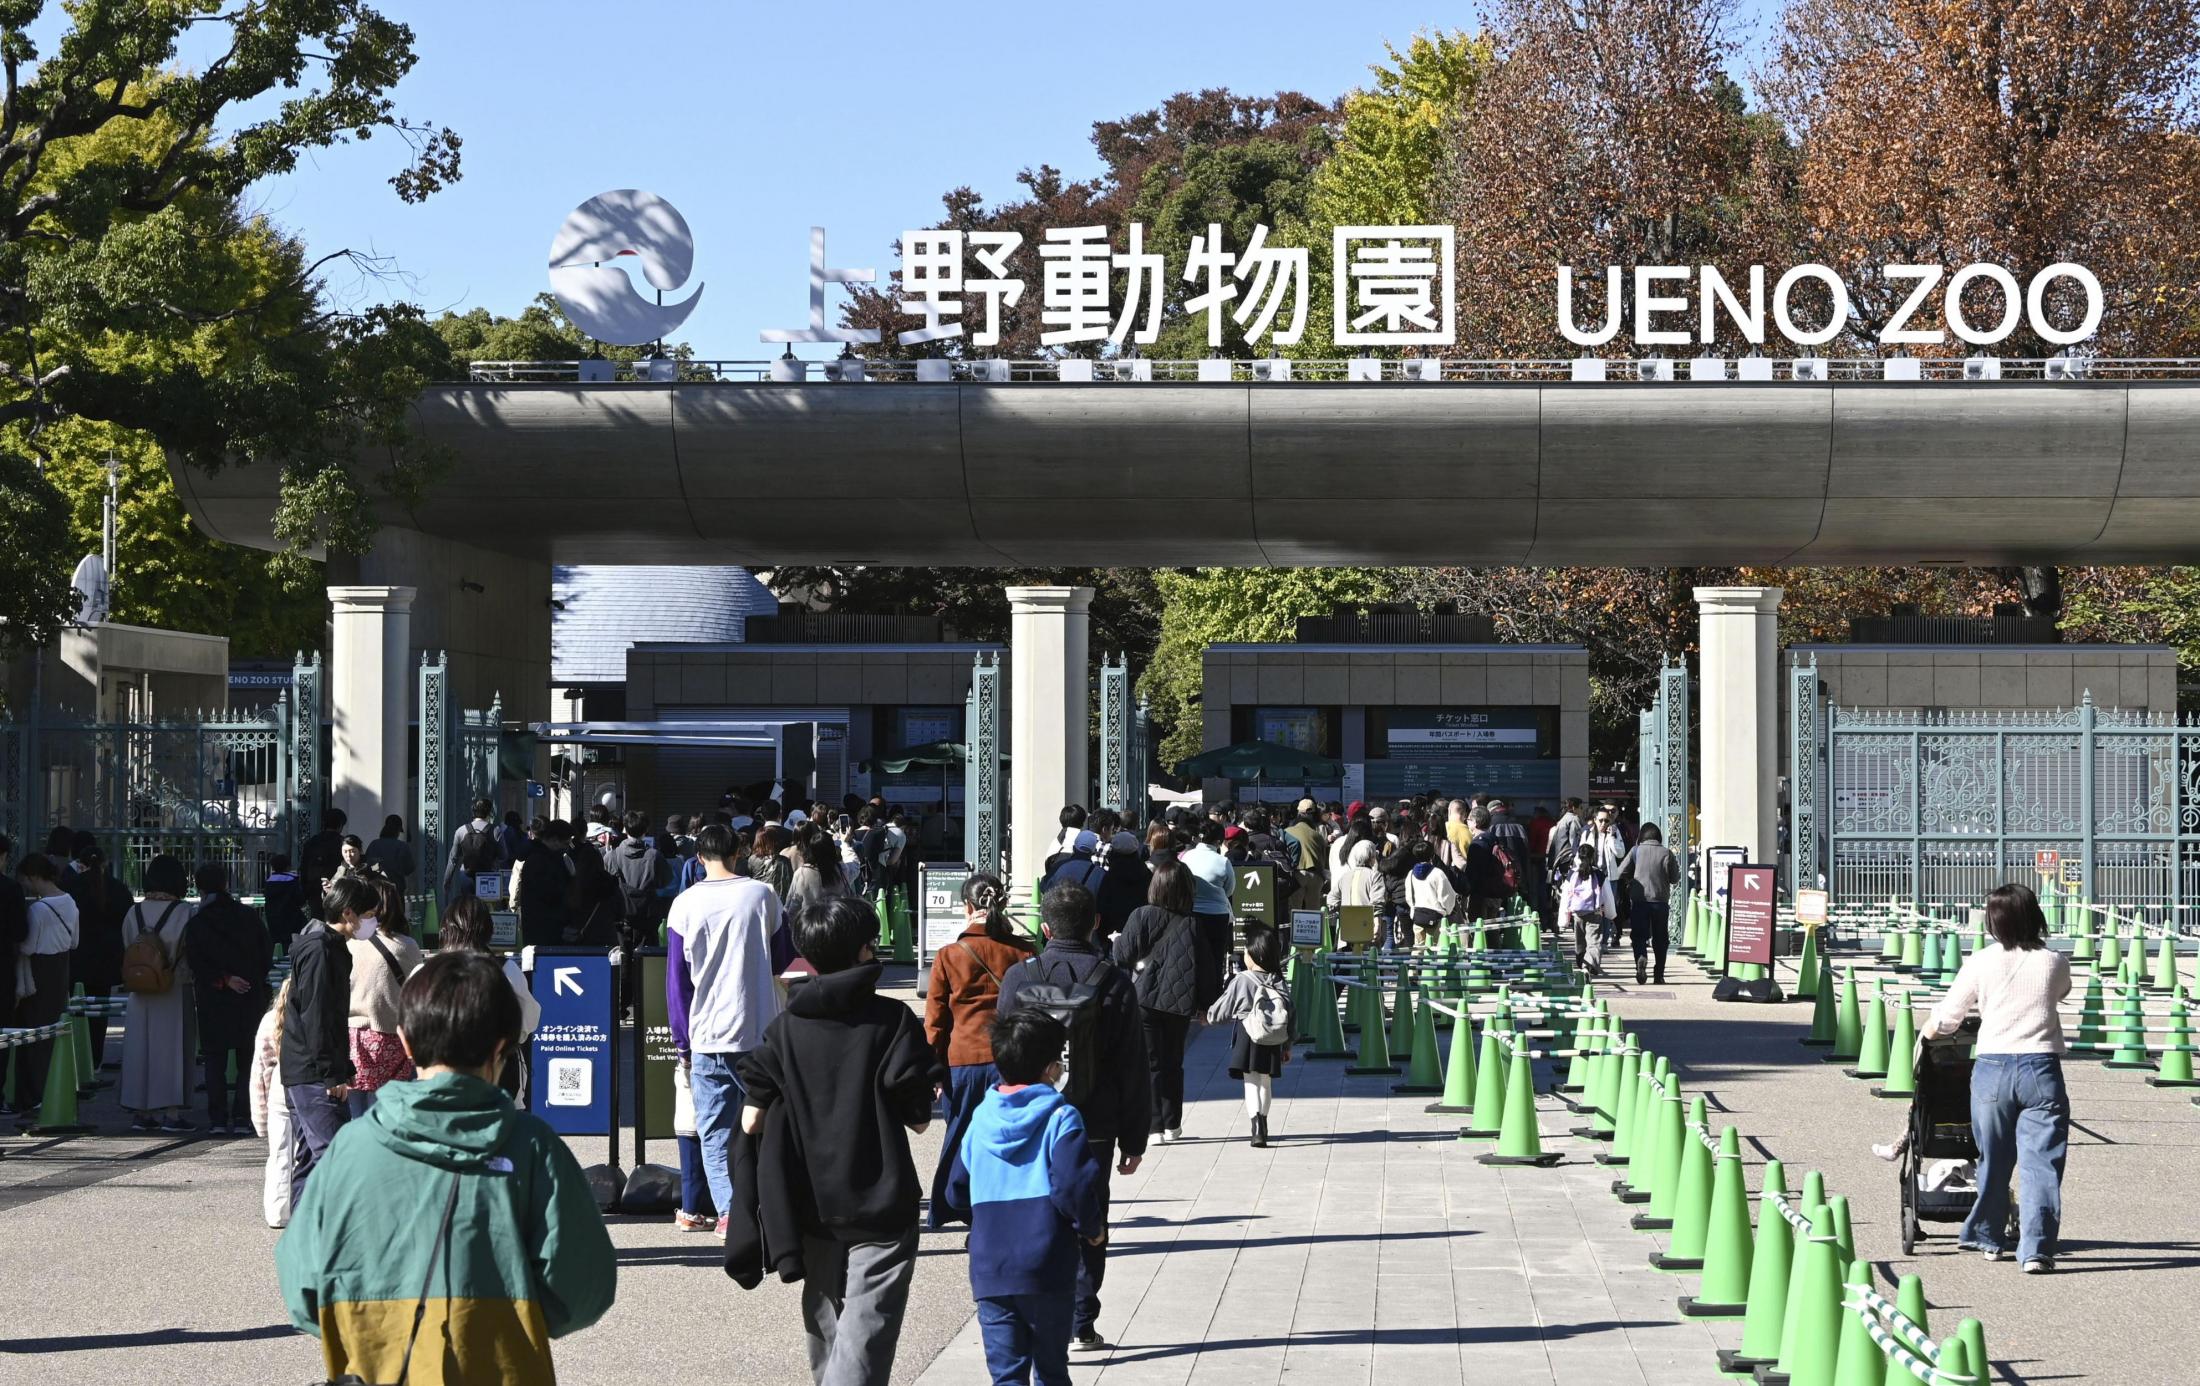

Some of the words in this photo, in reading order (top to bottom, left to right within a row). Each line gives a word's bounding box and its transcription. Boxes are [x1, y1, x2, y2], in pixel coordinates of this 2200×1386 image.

[760, 222, 1456, 347] 上野動物園
[1557, 263, 1849, 346] UENO
[1879, 262, 2104, 346] ZOO
[250, 676, 270, 684] ZOO
[1436, 714, 1488, 723] チケット窓口
[536, 784, 545, 796] 3
[932, 895, 945, 904] 70
[533, 1033, 607, 1041] 入場券を購入済みの方
